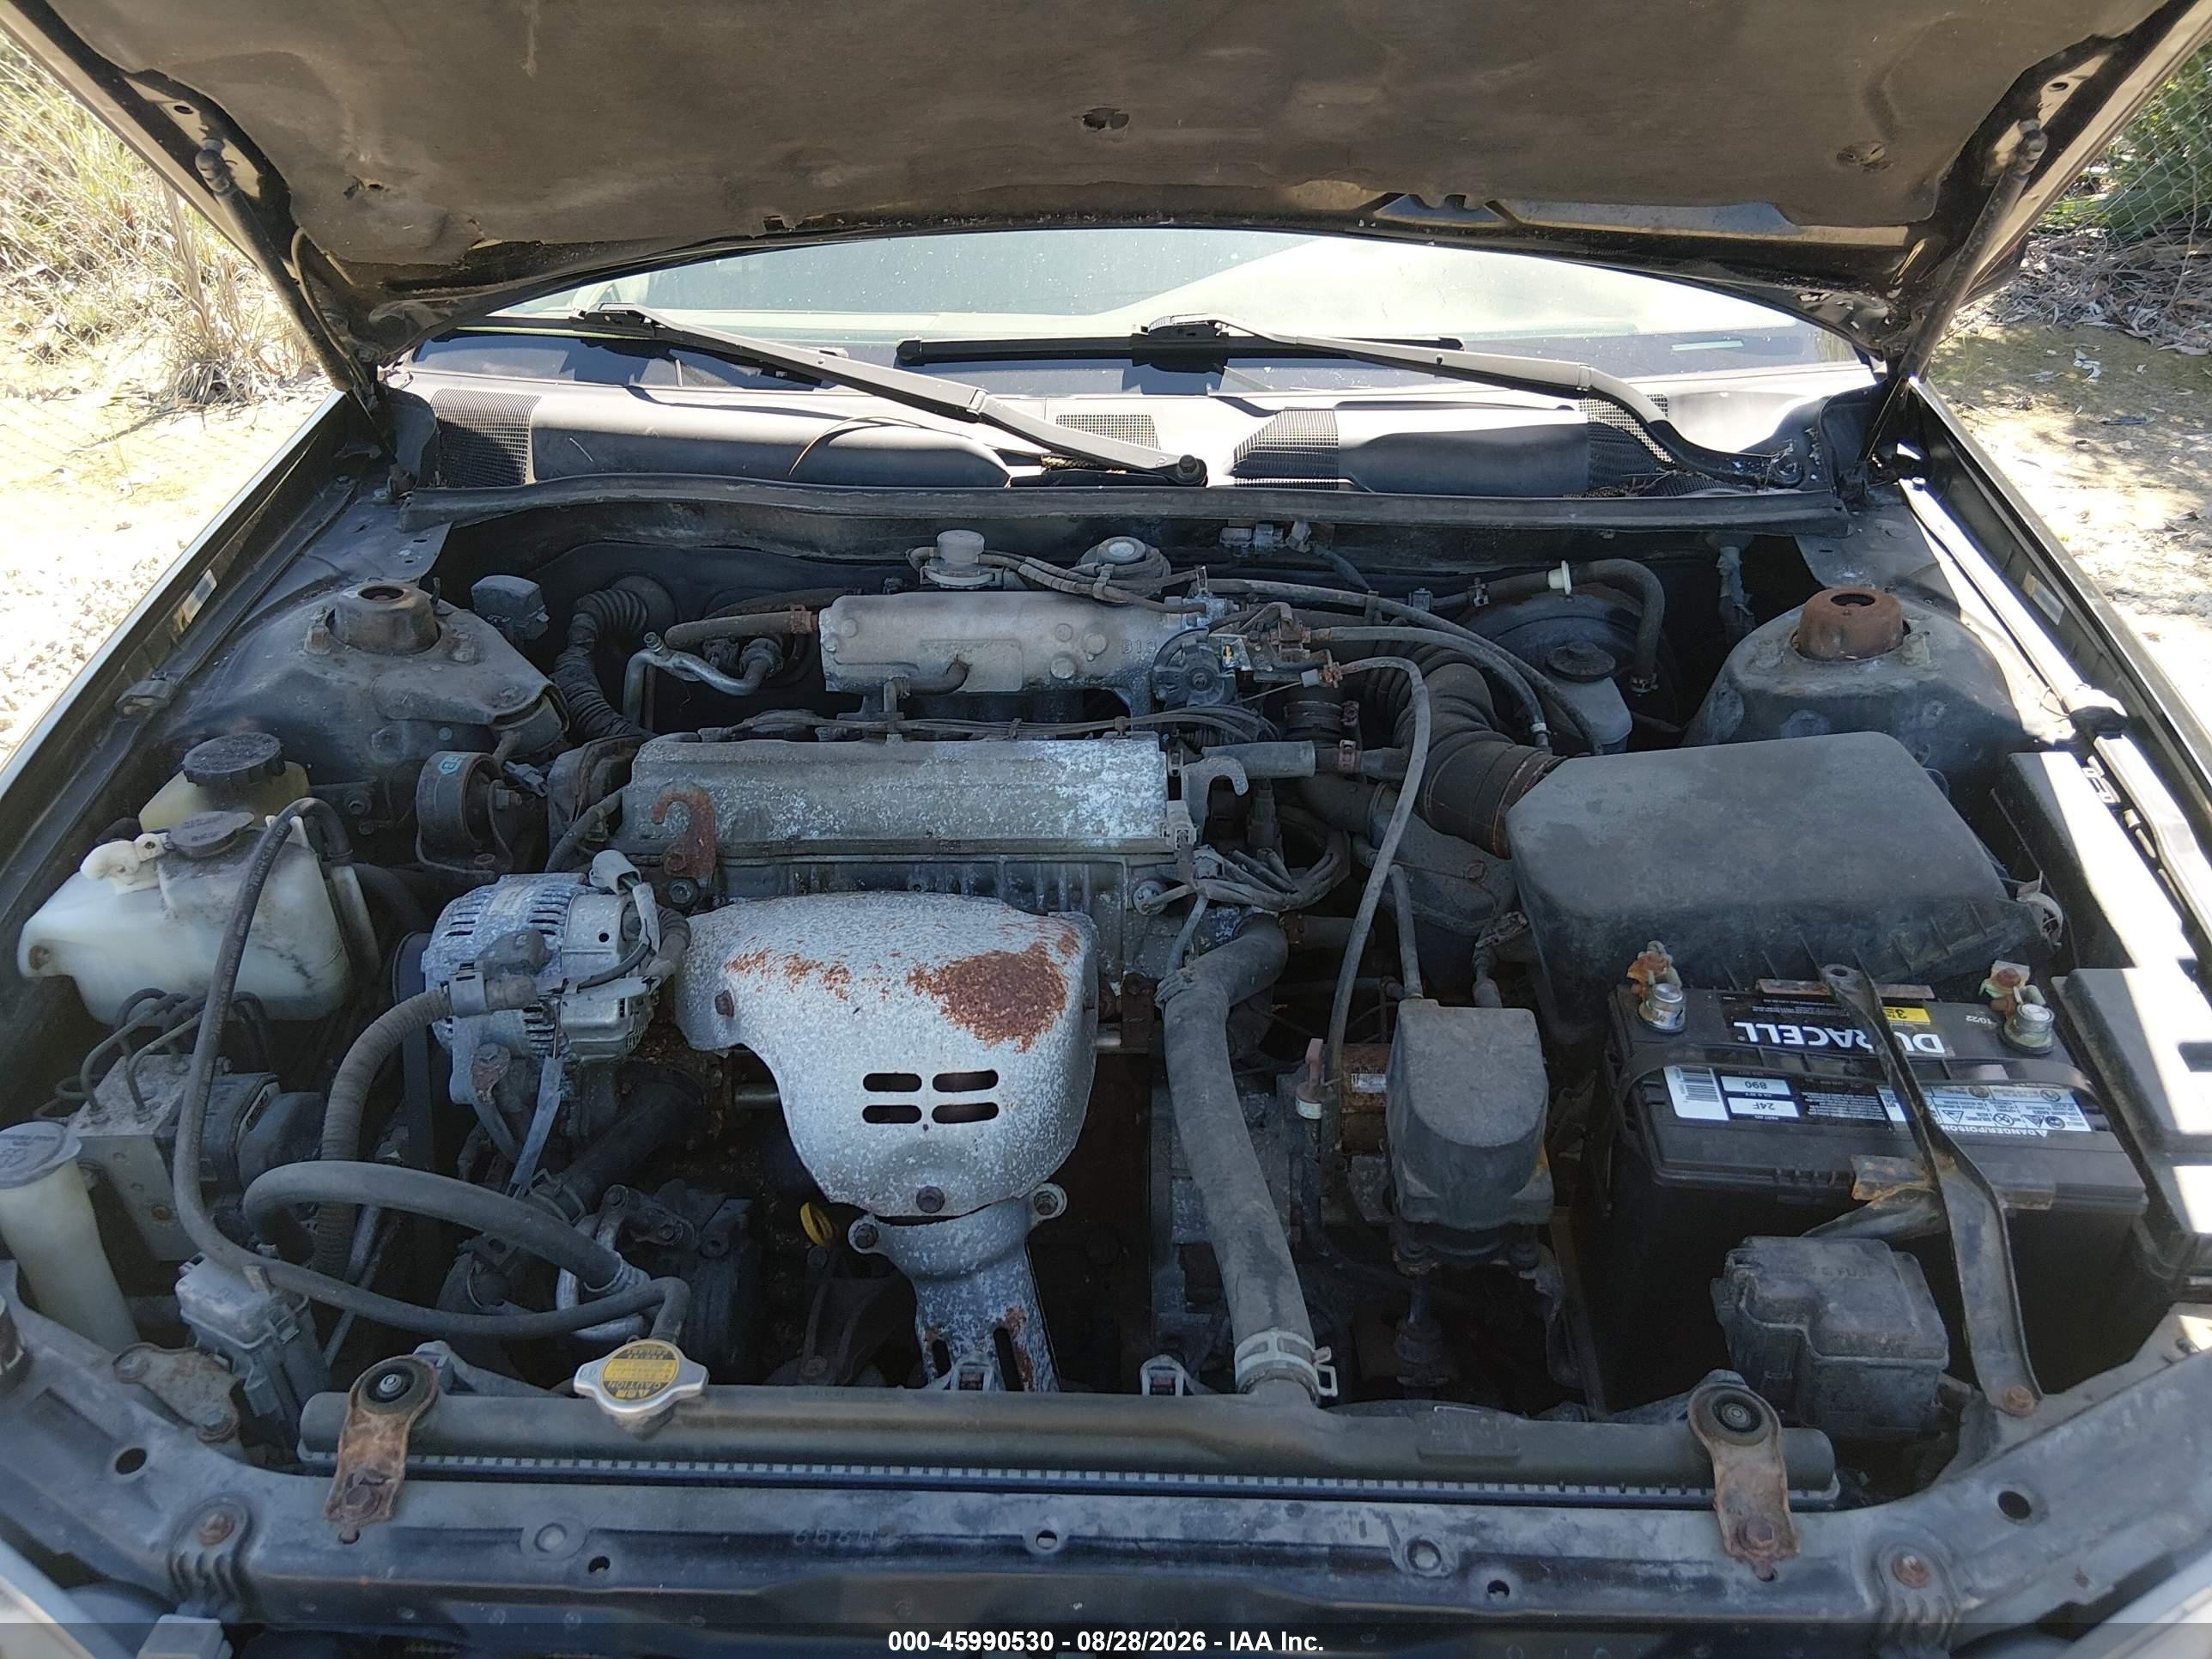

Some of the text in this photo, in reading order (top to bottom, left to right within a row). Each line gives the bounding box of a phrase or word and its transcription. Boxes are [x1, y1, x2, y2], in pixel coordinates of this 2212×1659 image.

[1895, 1009, 1907, 1019] 3
[1744, 1081, 1767, 1090] 890
[1752, 1103, 1776, 1111] 24F
[606, 1381, 660, 1390] CAUTION
